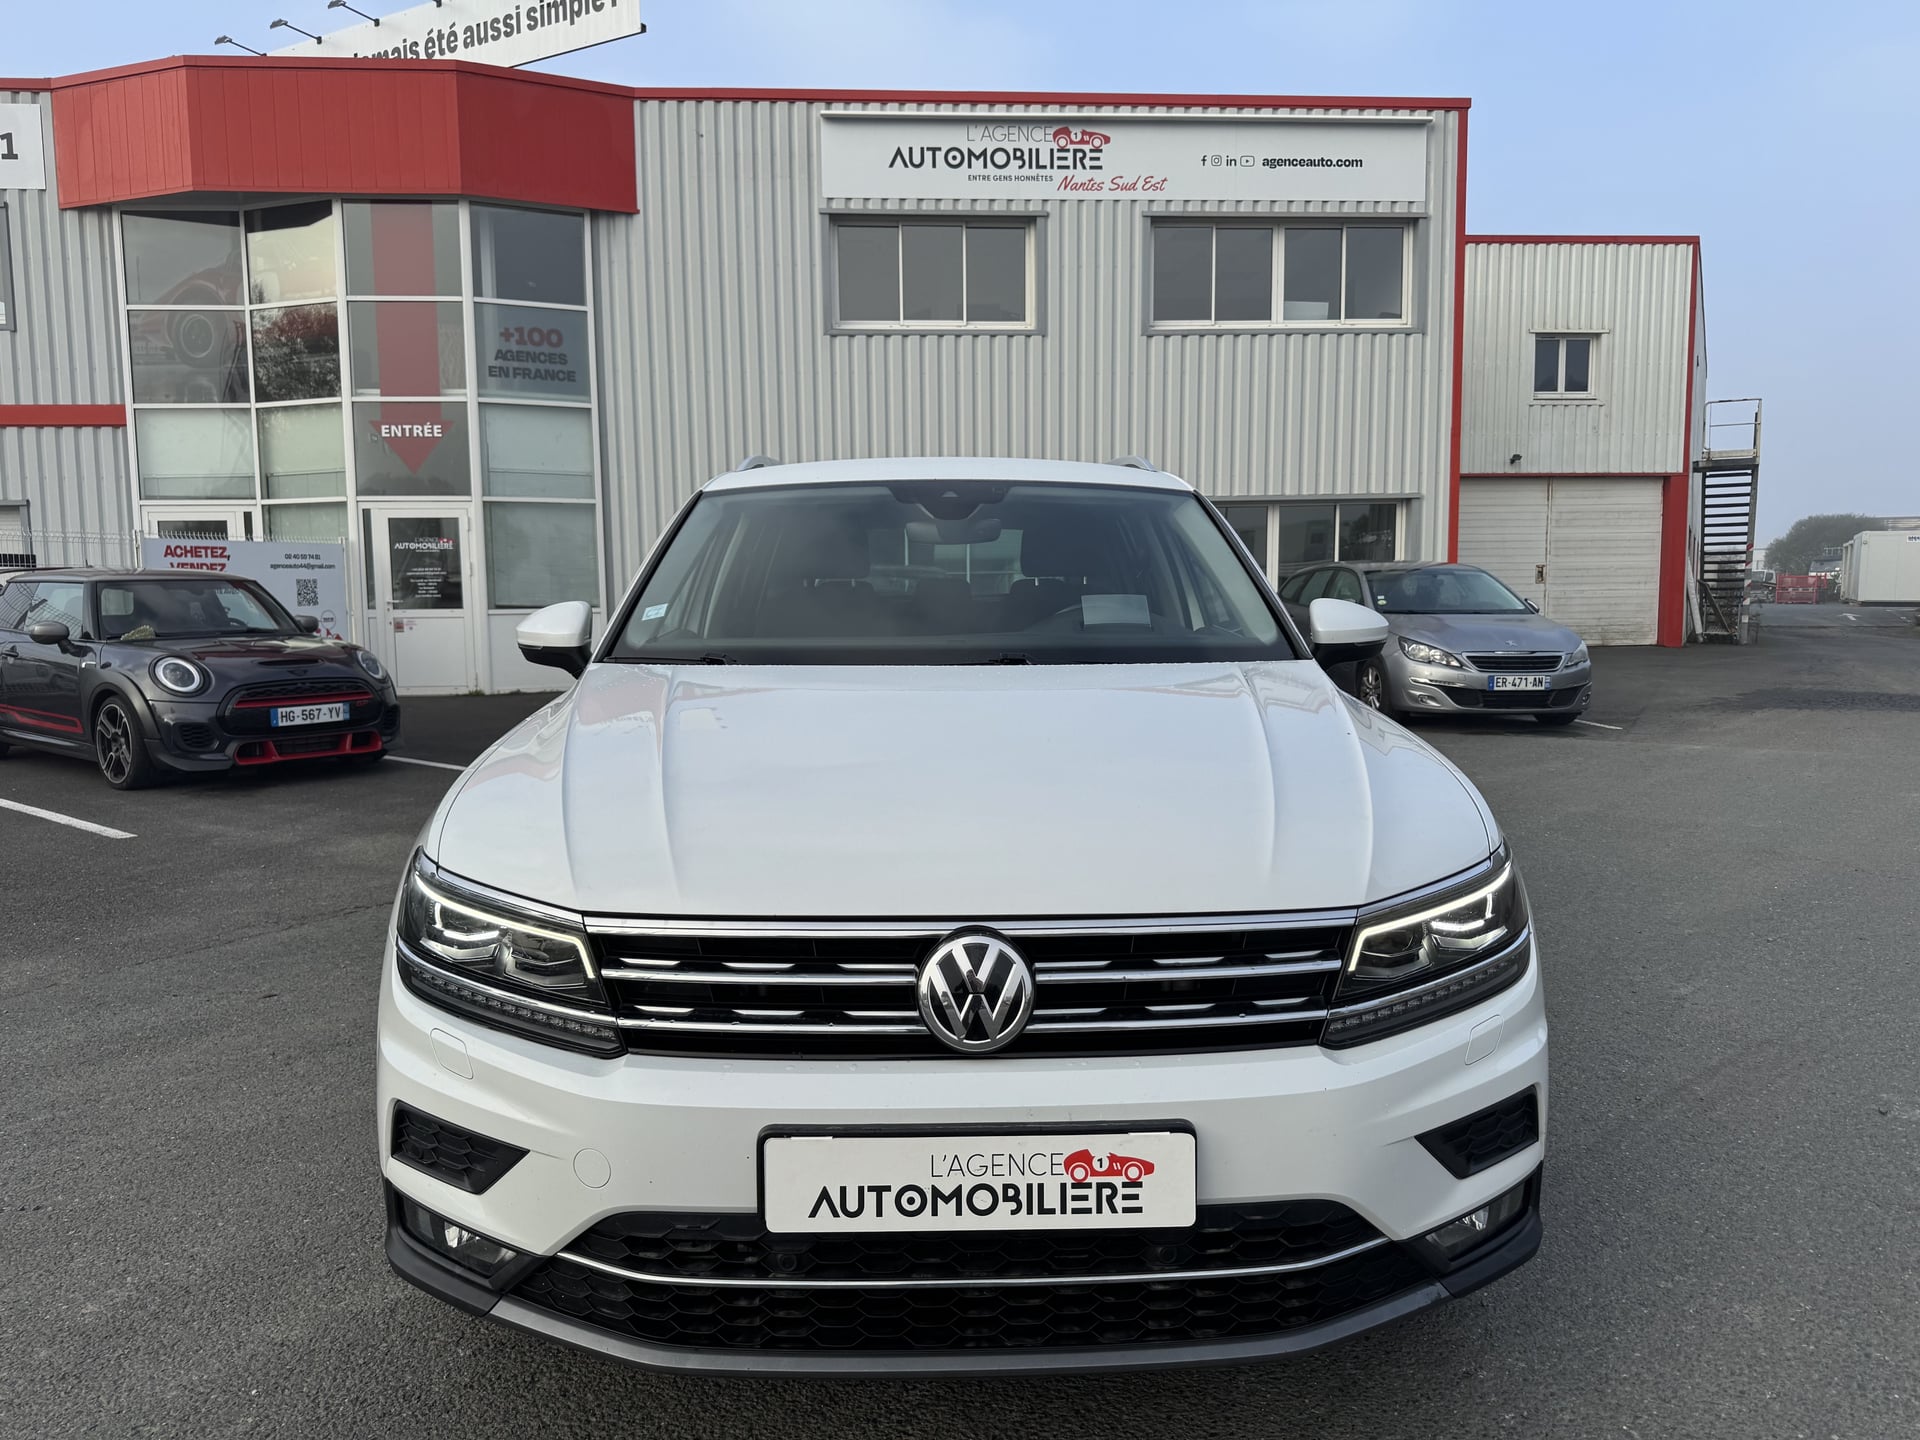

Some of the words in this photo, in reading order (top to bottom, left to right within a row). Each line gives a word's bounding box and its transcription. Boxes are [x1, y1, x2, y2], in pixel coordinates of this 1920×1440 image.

[424, 22, 458, 59] été
[463, 6, 522, 49] aussi
[966, 125, 1053, 143] L'AGENCE
[1262, 156, 1363, 169] agenceauto.com
[968, 174, 991, 183] ENTRE
[993, 174, 1013, 183] GENS
[1014, 173, 1053, 183] HONNÊTES
[1056, 175, 1104, 192] Nantes
[1108, 175, 1142, 192] Sud
[1142, 176, 1168, 192] Est
[500, 326, 564, 348] +100
[494, 349, 568, 366] AGENCES
[488, 365, 510, 379] EN
[513, 367, 576, 383] FRANCE
[381, 422, 443, 438] ENTRÉE
[164, 544, 230, 561] ACHETEZ,
[280, 705, 341, 723] HG-567-YV
[931, 1152, 1064, 1178] L'AGENCE
